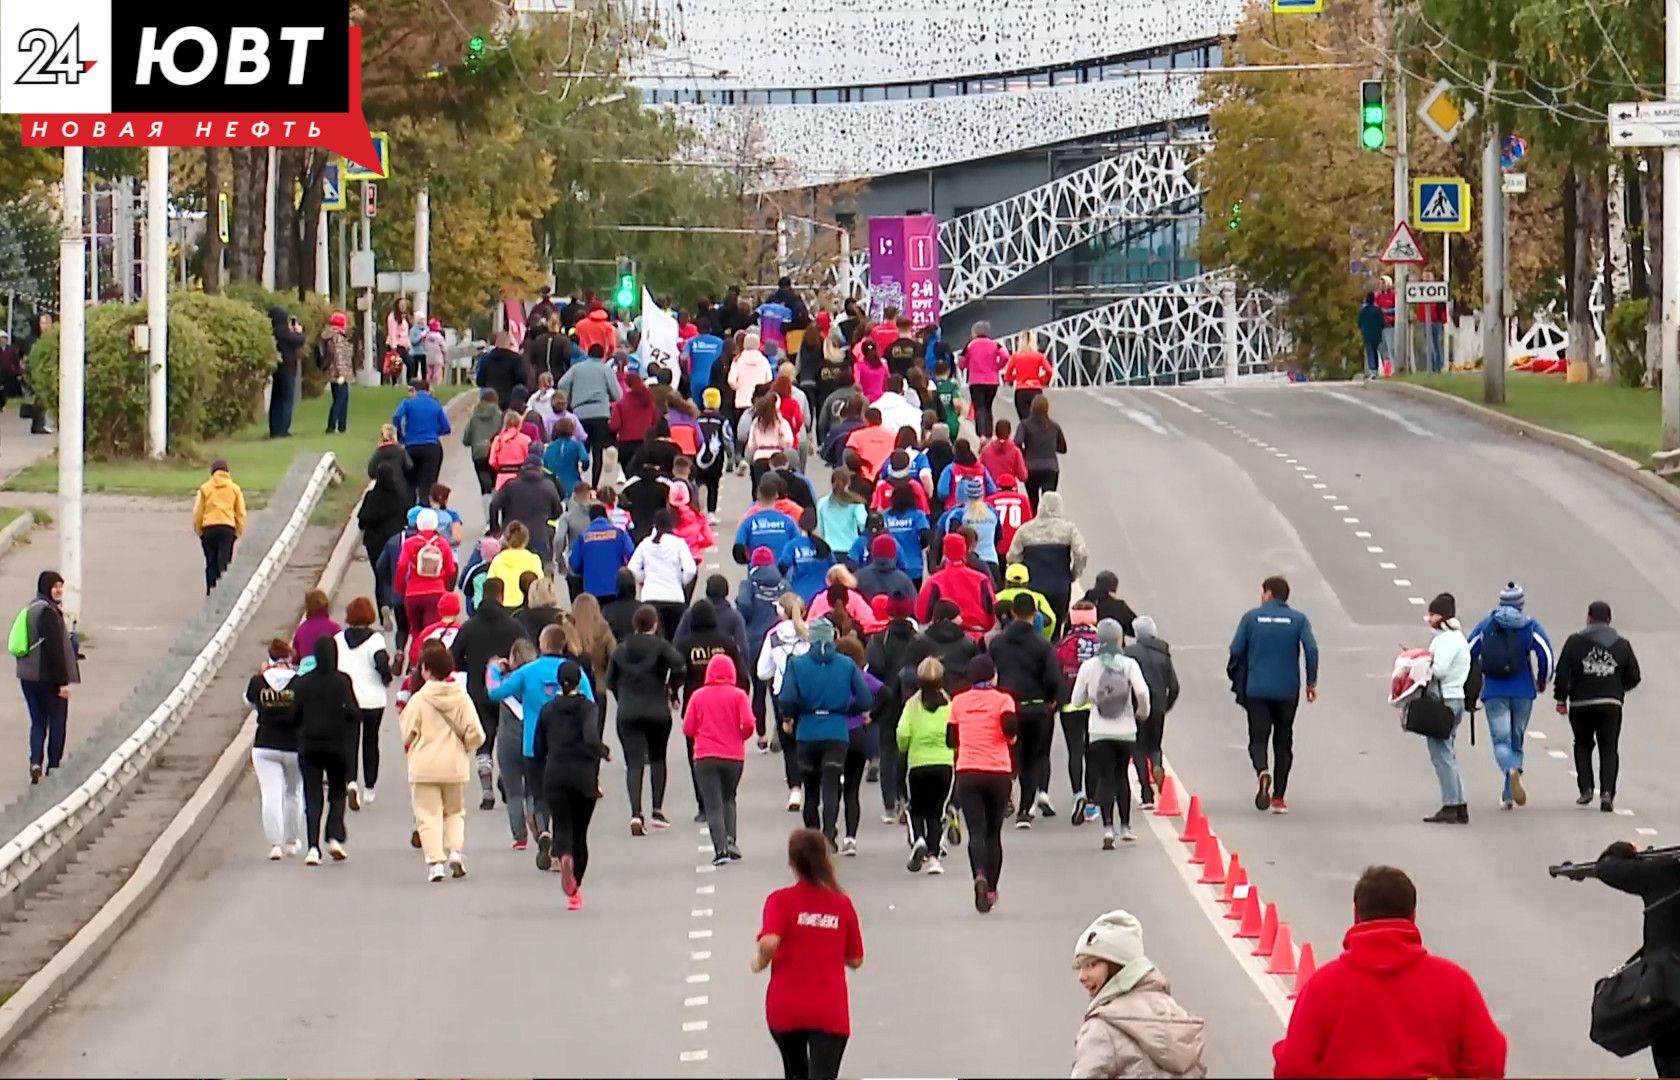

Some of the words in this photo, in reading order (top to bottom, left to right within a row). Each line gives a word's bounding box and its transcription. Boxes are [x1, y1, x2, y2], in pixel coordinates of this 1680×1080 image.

[911, 278, 934, 297] 2-Й
[1407, 282, 1447, 298] СТОП
[911, 299, 933, 309] КРУГ
[912, 311, 935, 323] 21.1
[995, 504, 1022, 528] 70
